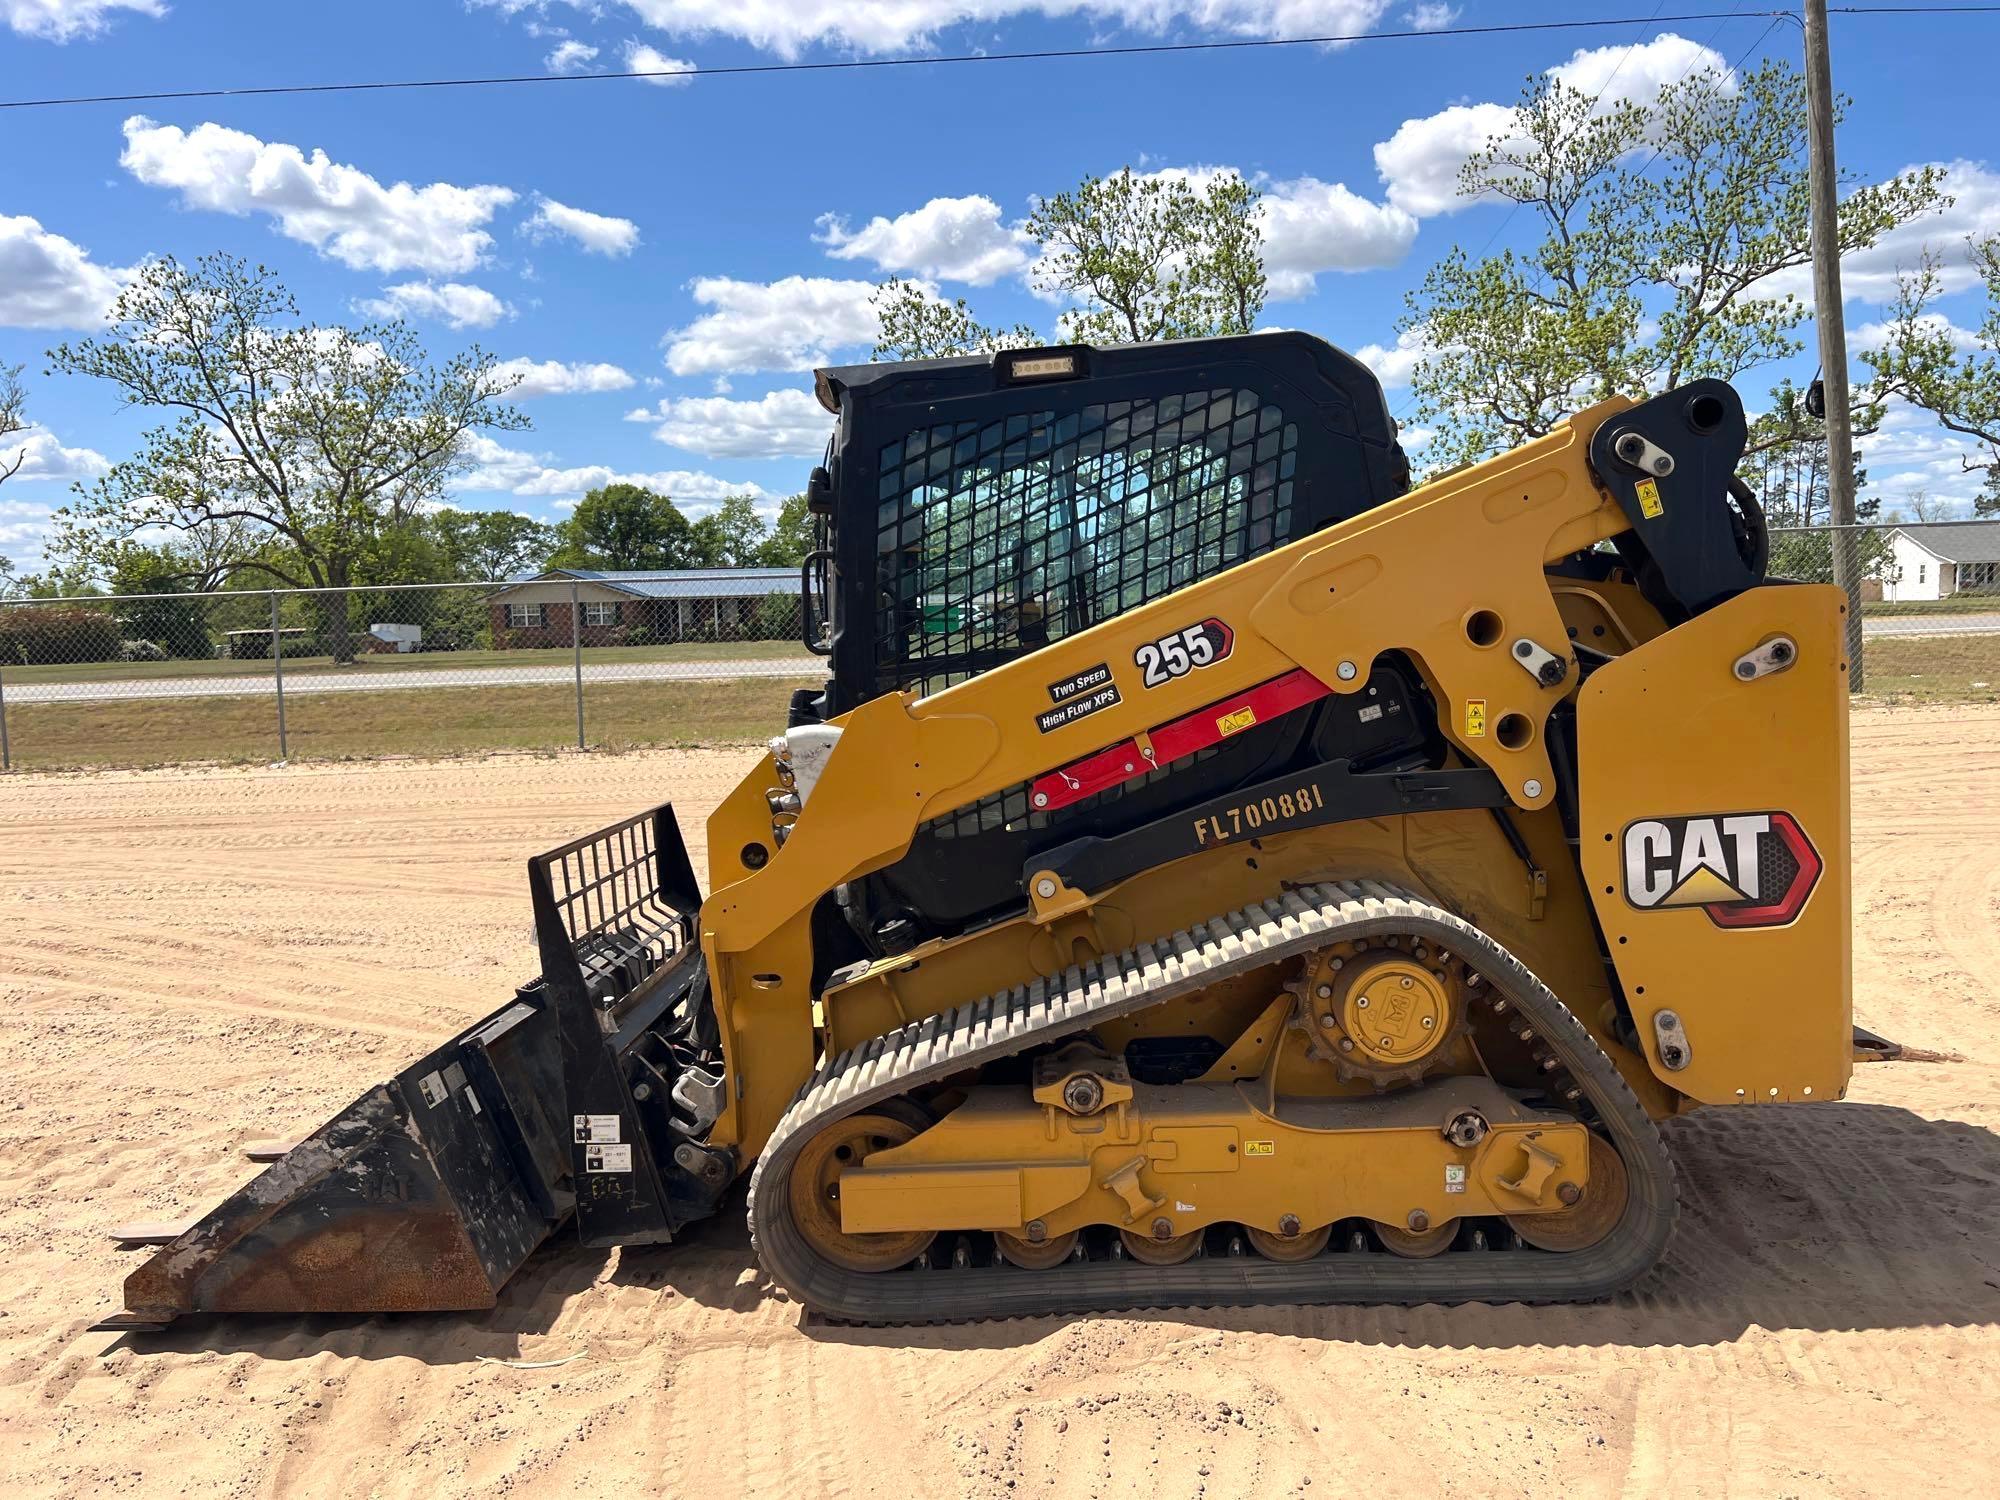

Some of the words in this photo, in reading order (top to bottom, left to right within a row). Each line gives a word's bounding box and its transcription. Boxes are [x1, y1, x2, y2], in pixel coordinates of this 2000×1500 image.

[1136, 624, 1214, 686] 255
[1094, 690, 1115, 708] XPS
[1625, 814, 1770, 906] CAT
[1384, 993, 1411, 1032] CAT
